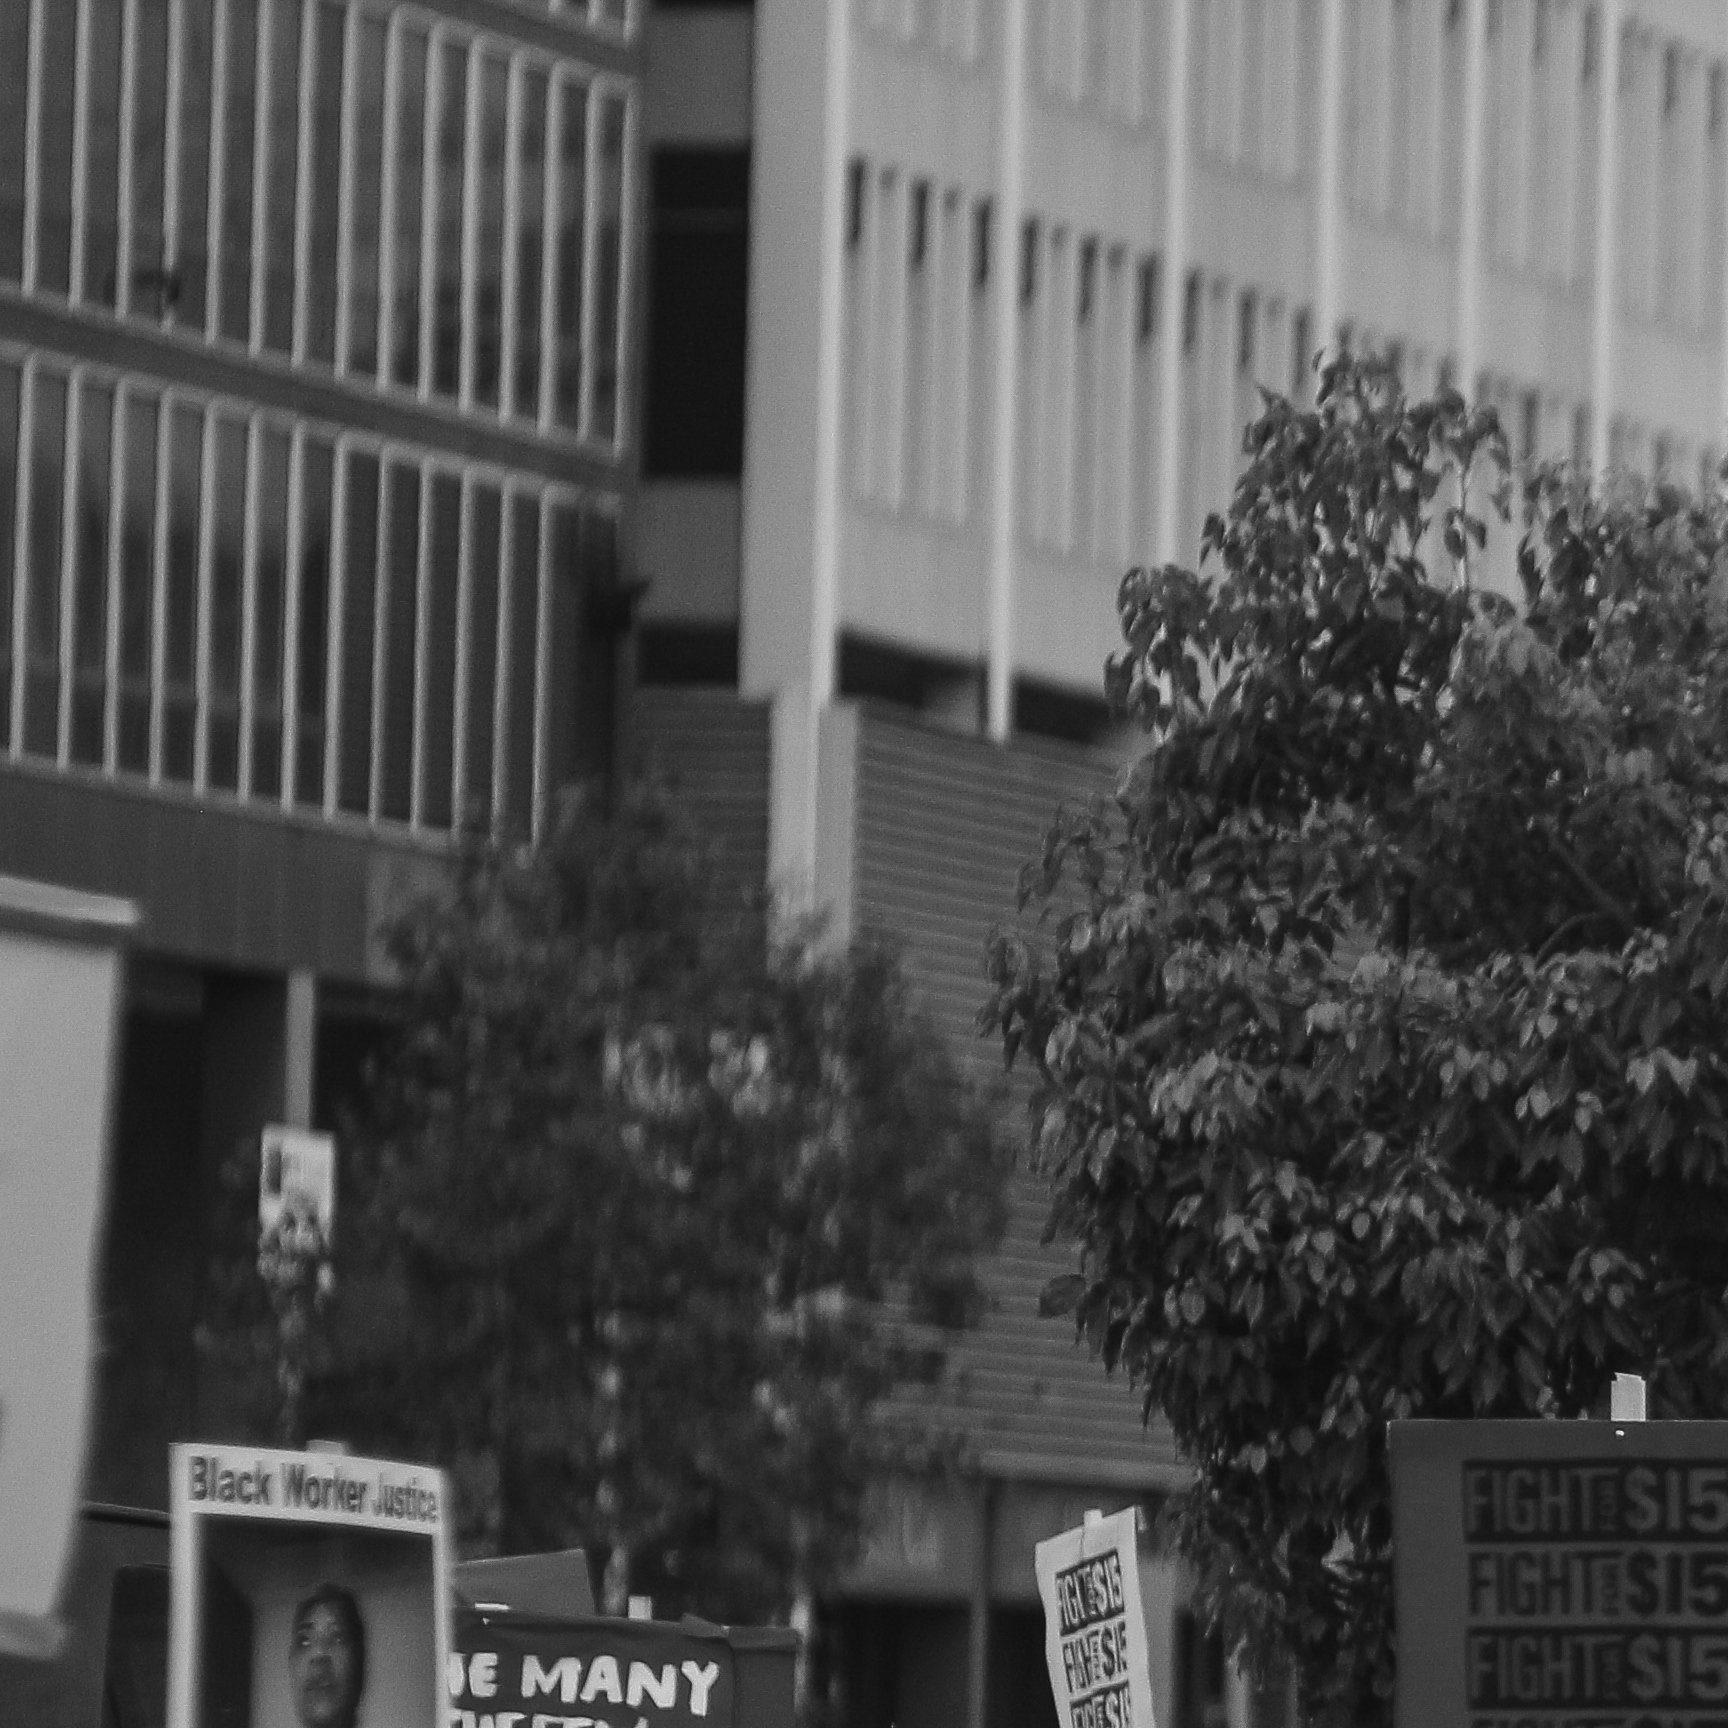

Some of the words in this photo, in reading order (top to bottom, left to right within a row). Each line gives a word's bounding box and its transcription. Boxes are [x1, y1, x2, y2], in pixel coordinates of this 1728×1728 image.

[190, 1455, 271, 1504] Black
[279, 1461, 367, 1514] Worker
[374, 1472, 437, 1523] Justice
[1466, 1468, 1619, 1533] FIGHT
[1469, 1551, 1623, 1617] FIGHT
[521, 1655, 719, 1717] MANY
[1469, 1635, 1624, 1699] FIGHT
